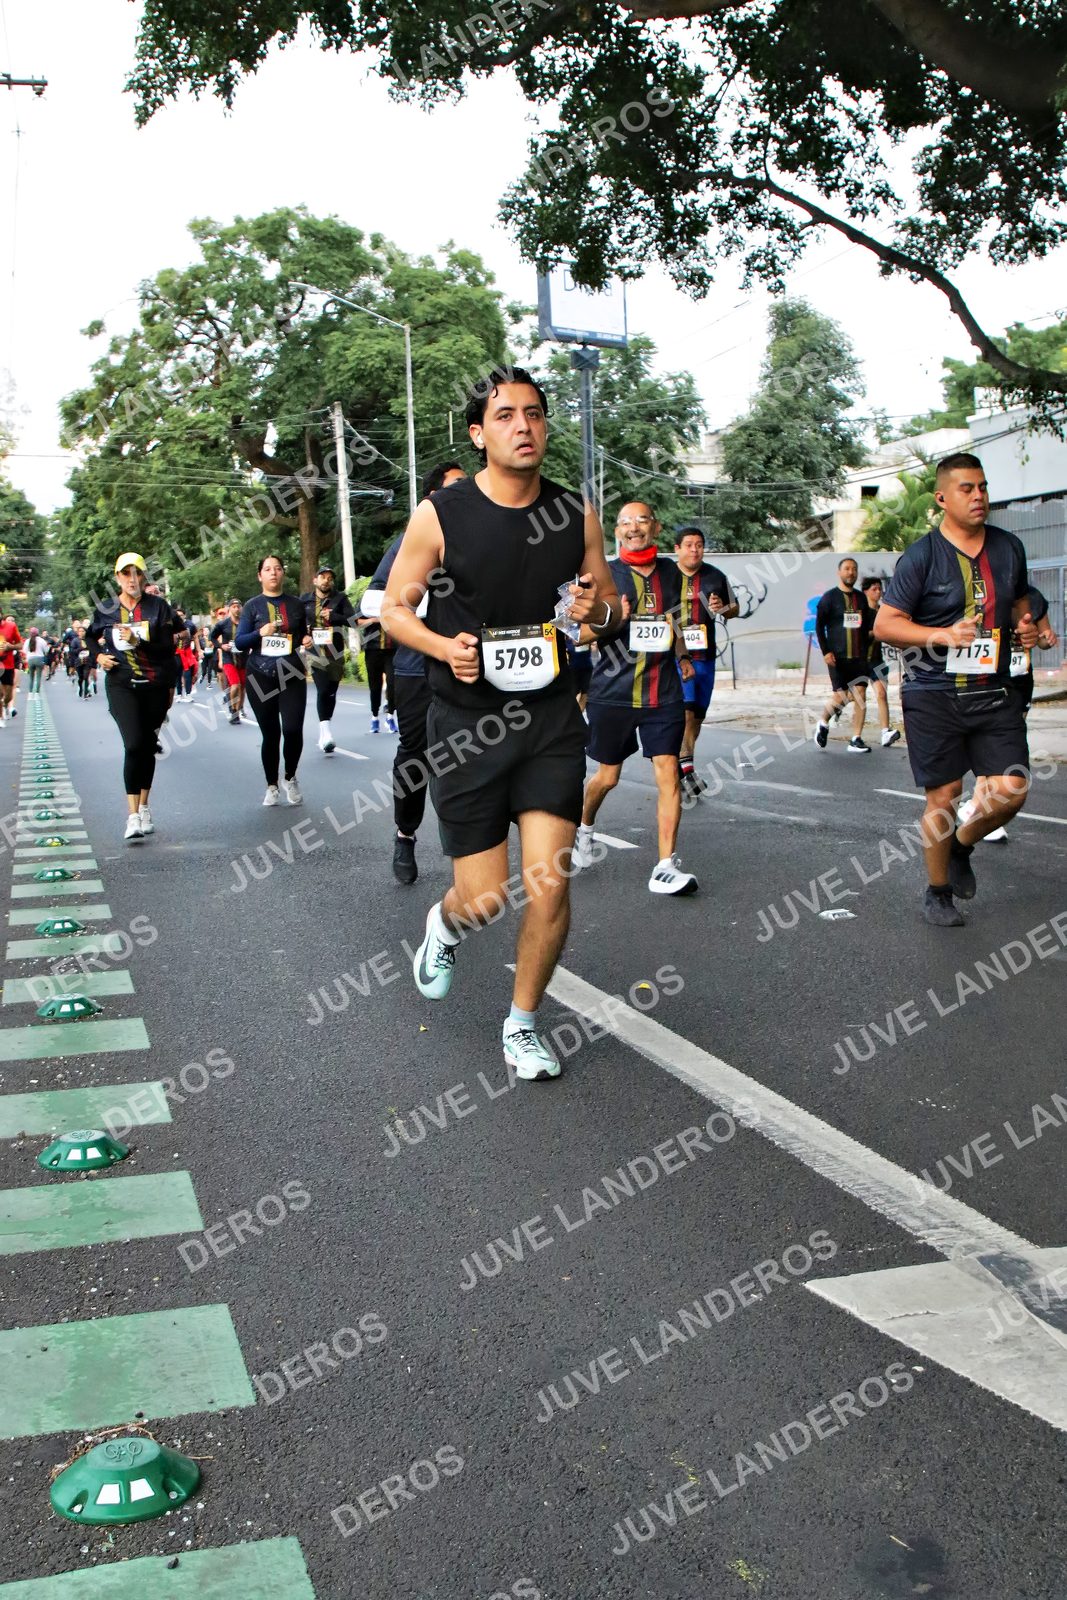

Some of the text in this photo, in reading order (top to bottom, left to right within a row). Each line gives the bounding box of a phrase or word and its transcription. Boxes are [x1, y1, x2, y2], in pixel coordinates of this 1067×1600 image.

[636, 626, 666, 639] 2307
[265, 639, 286, 649] 7095
[495, 645, 544, 671] 5798
[1011, 655, 1022, 666] 97
